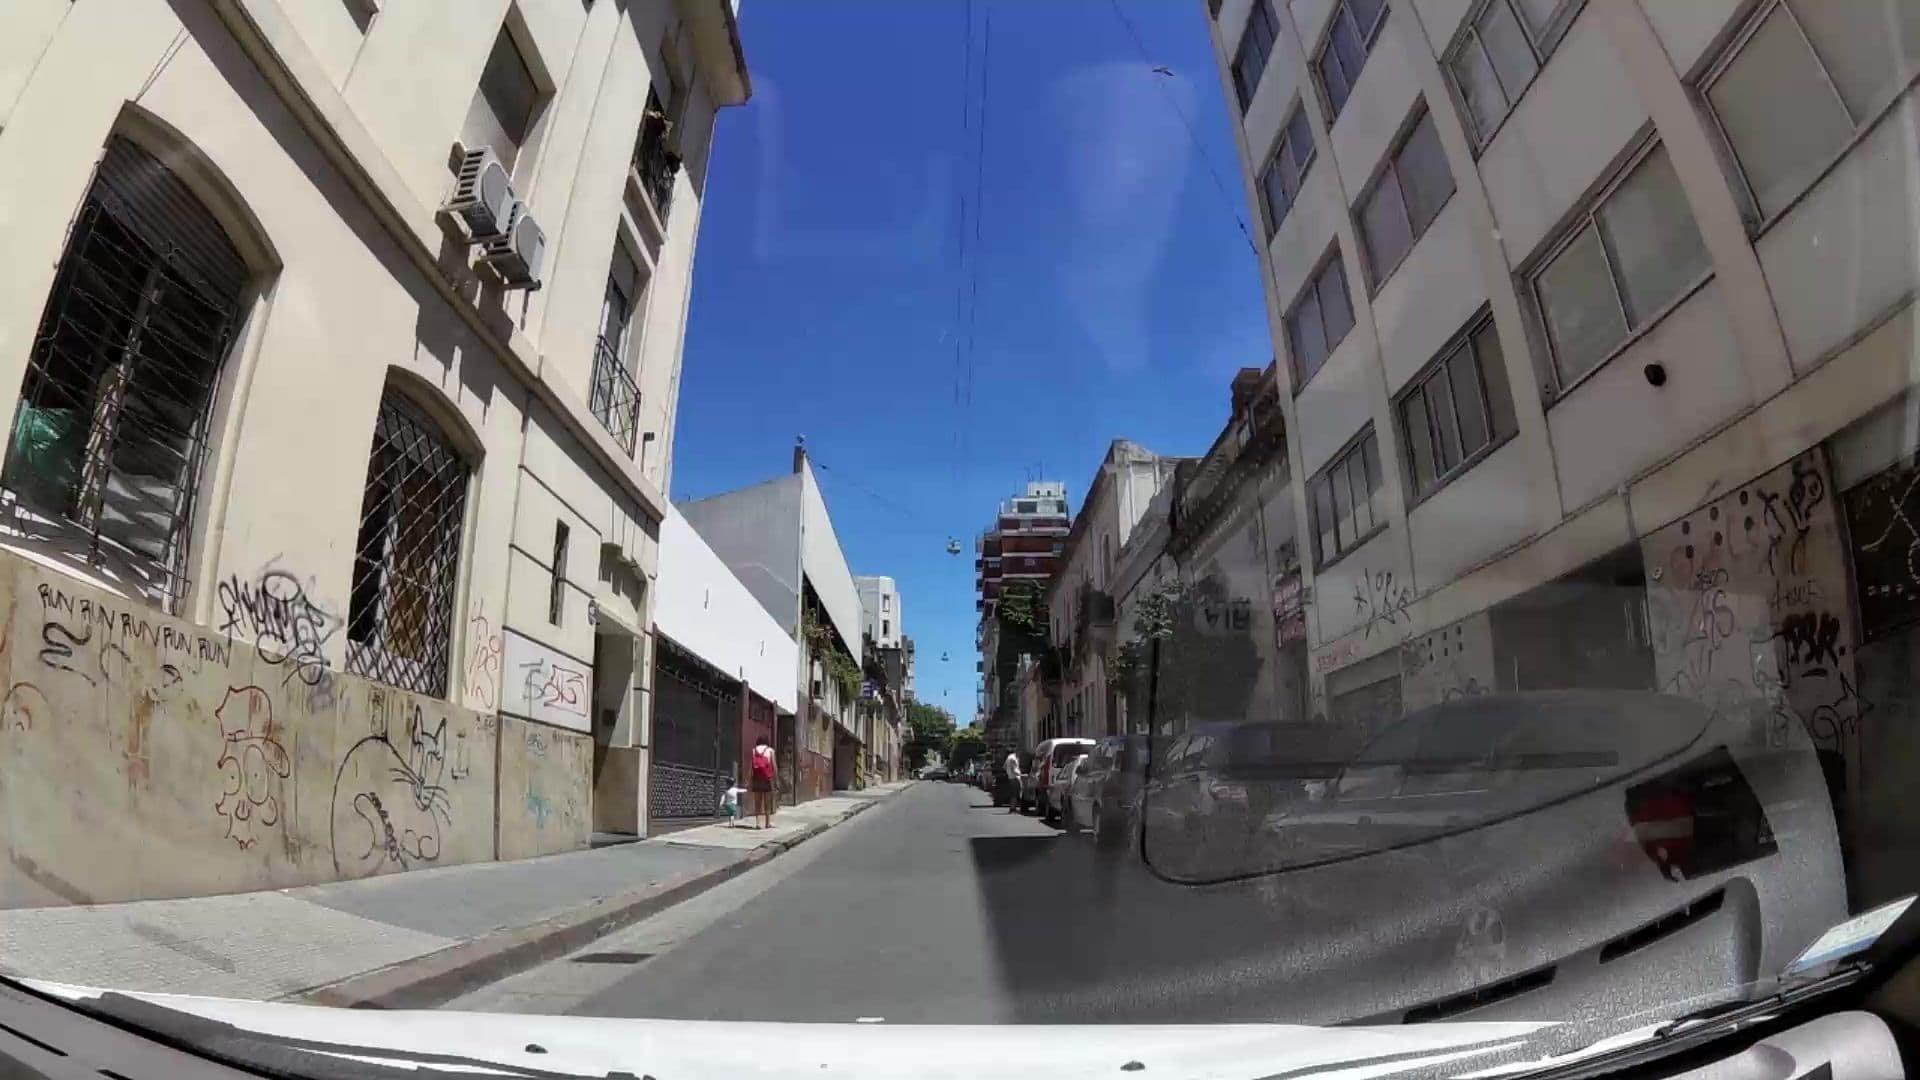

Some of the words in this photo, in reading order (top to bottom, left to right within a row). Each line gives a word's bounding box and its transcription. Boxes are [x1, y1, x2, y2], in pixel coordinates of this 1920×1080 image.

[38, 583, 74, 618] RUN
[80, 599, 115, 631] RUN
[120, 613, 160, 647] RUN
[162, 627, 193, 655] RUN
[197, 637, 231, 669] RUN
